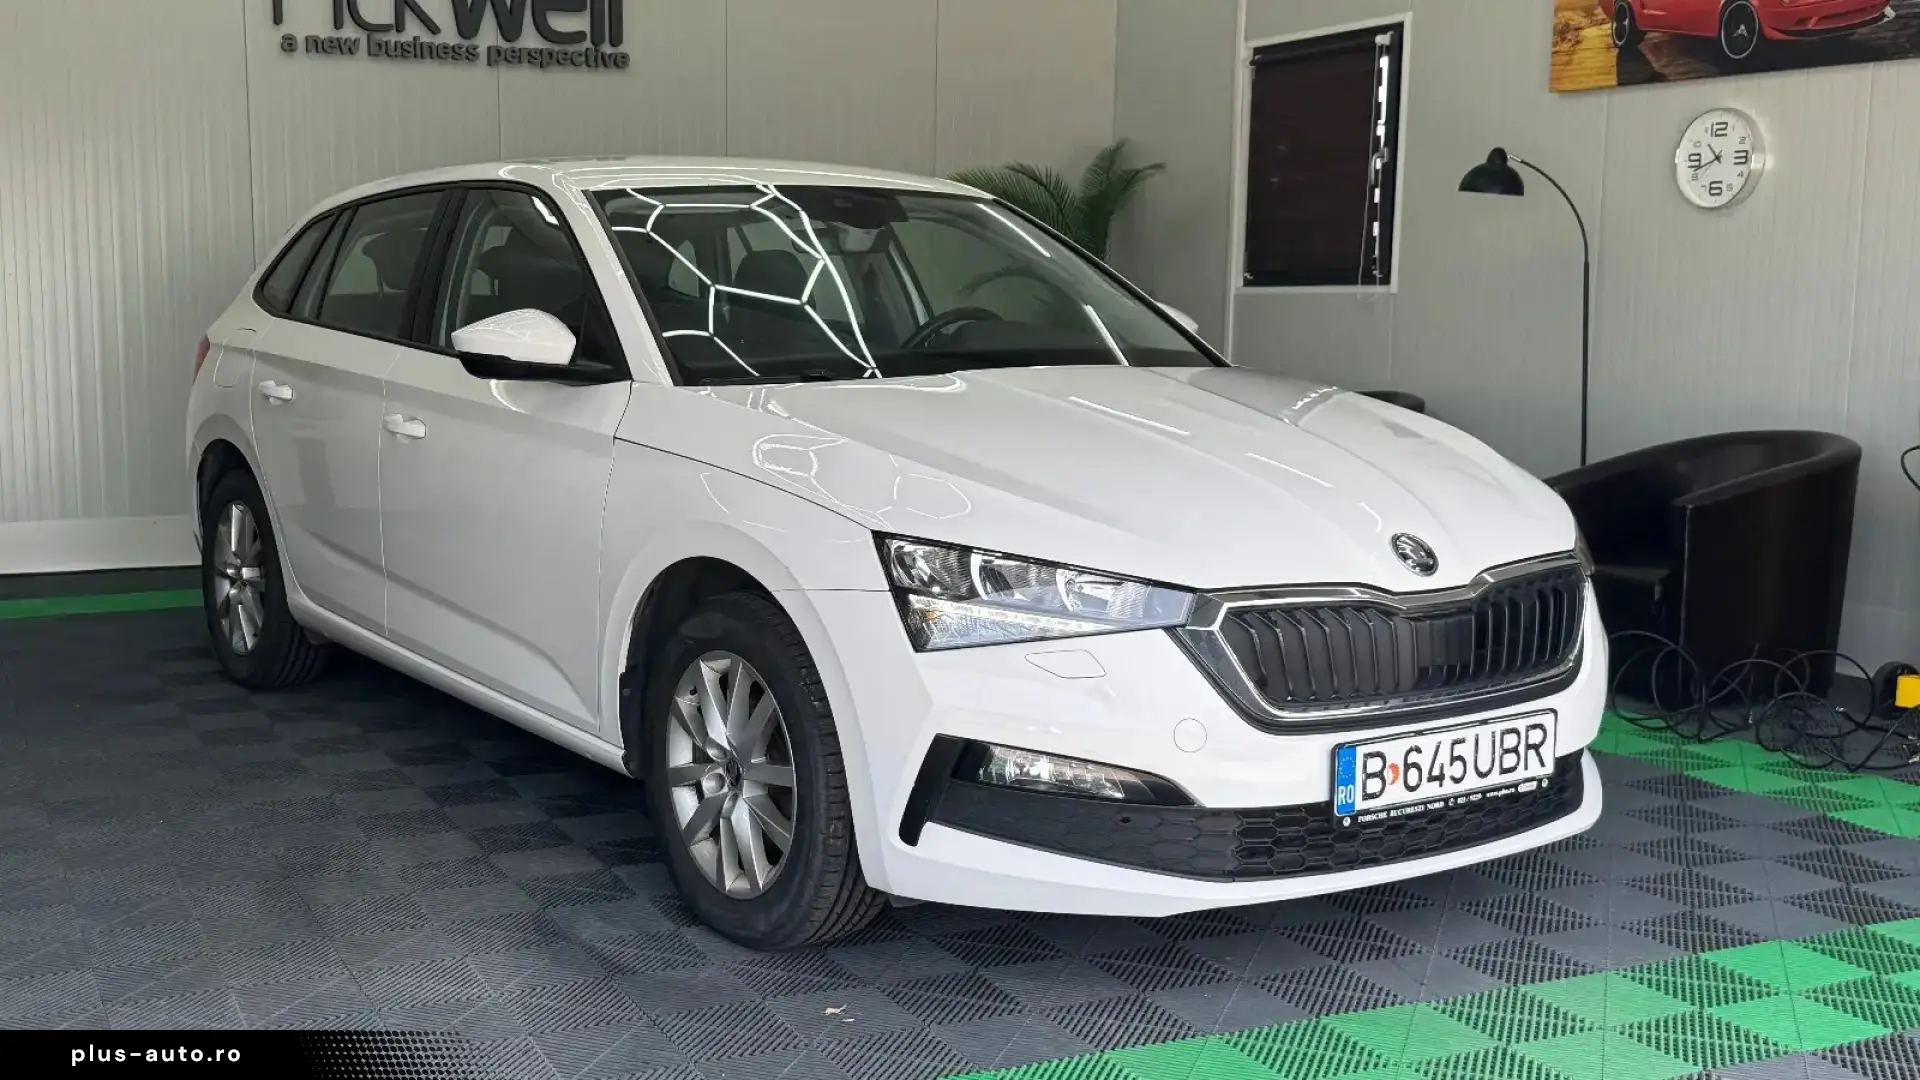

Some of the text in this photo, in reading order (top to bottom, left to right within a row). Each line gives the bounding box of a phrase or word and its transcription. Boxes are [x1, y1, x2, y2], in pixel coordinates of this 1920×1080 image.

[281, 33, 631, 68] a new business perspective
[1710, 121, 1729, 137] 12
[1687, 153, 1702, 169] 9
[1733, 149, 1749, 166] 3
[1708, 180, 1723, 197] 6
[1362, 751, 1387, 801] B
[1338, 785, 1354, 805] RO
[1357, 810, 1388, 823] PORSCHE
